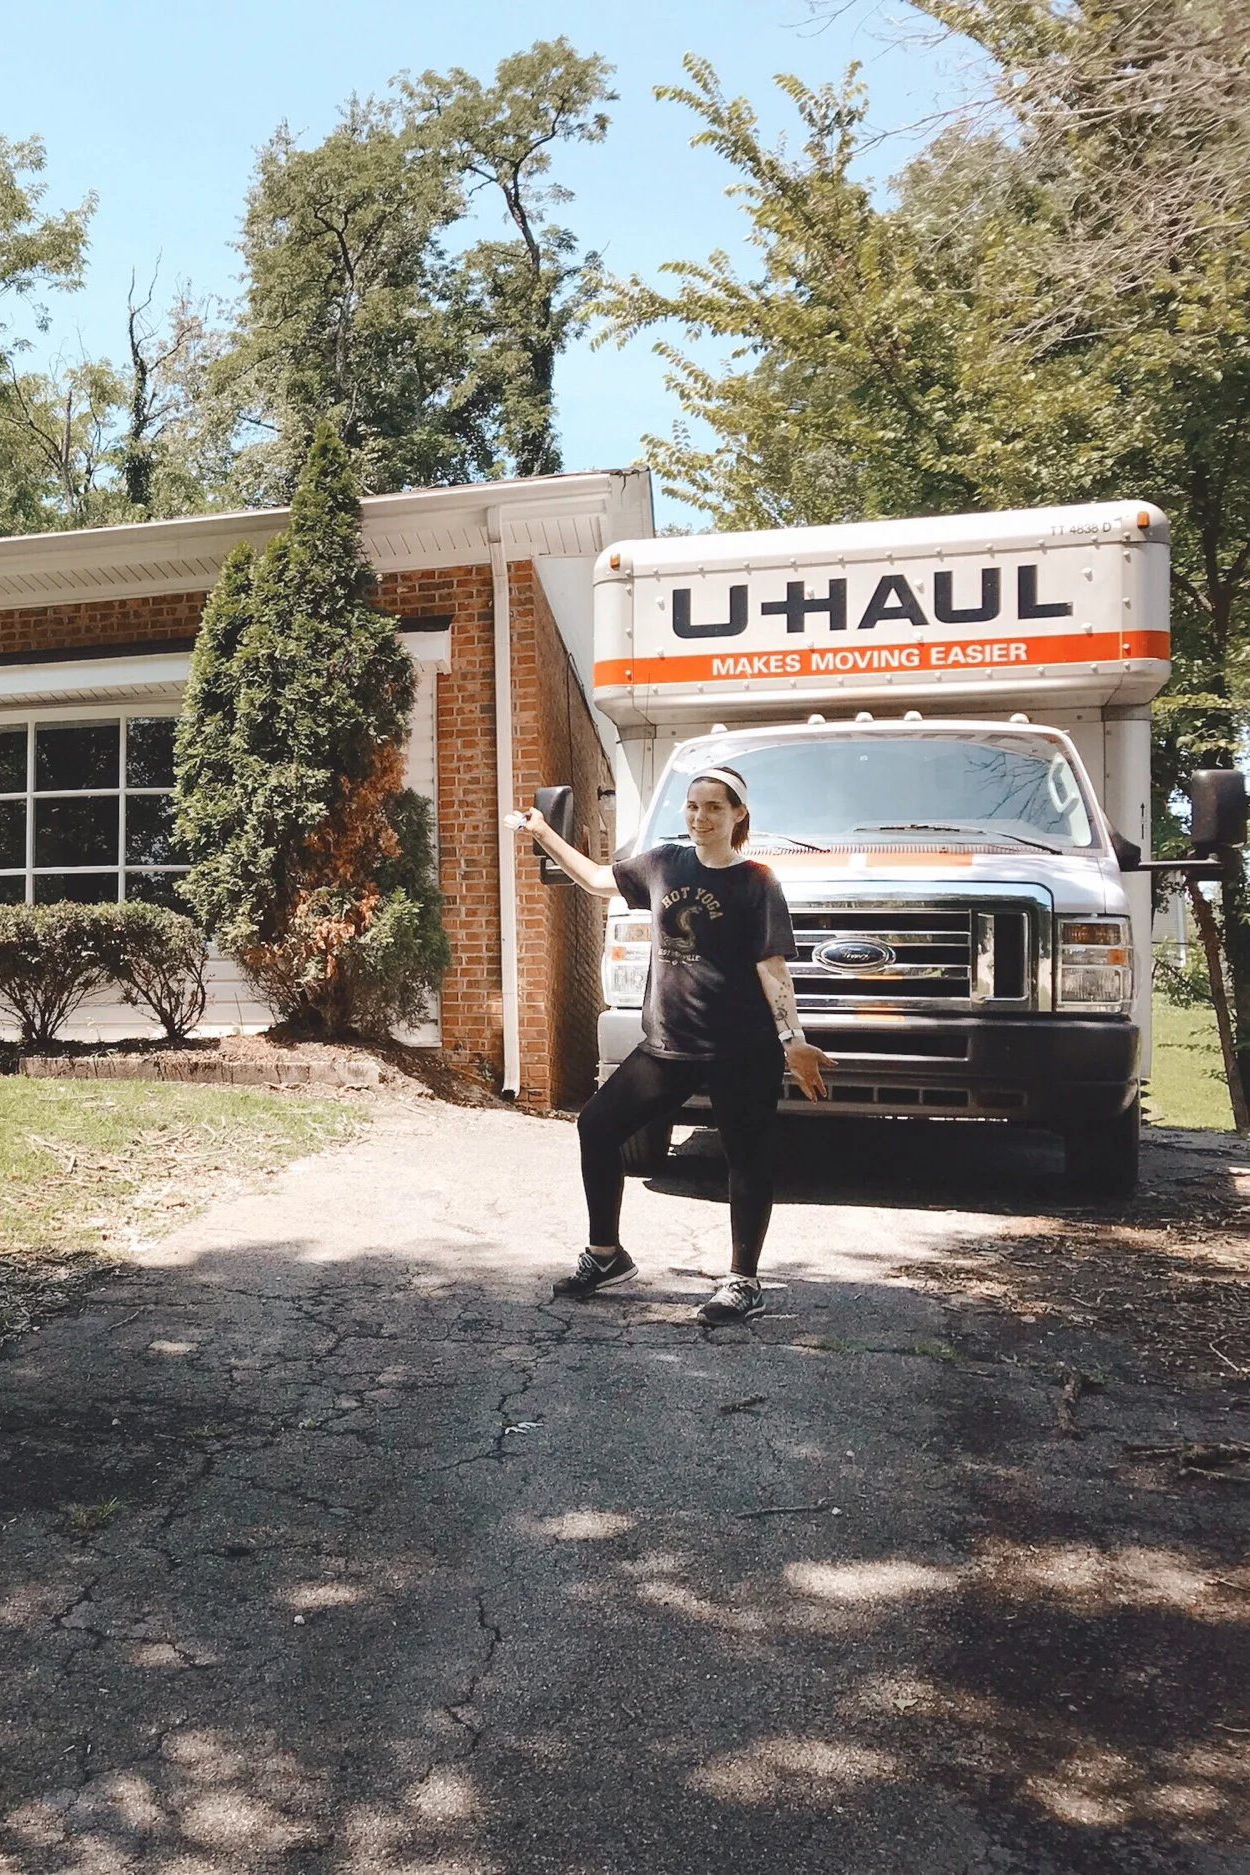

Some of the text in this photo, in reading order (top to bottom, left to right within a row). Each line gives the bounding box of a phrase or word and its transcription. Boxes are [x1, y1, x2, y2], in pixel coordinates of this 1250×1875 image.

[1069, 523, 1099, 534] 4838
[1103, 522, 1112, 532] D
[672, 565, 1073, 639] U-HAUL
[712, 642, 1028, 677] MAKES MOVING EASIER
[661, 886, 723, 920] HOT YOGA
